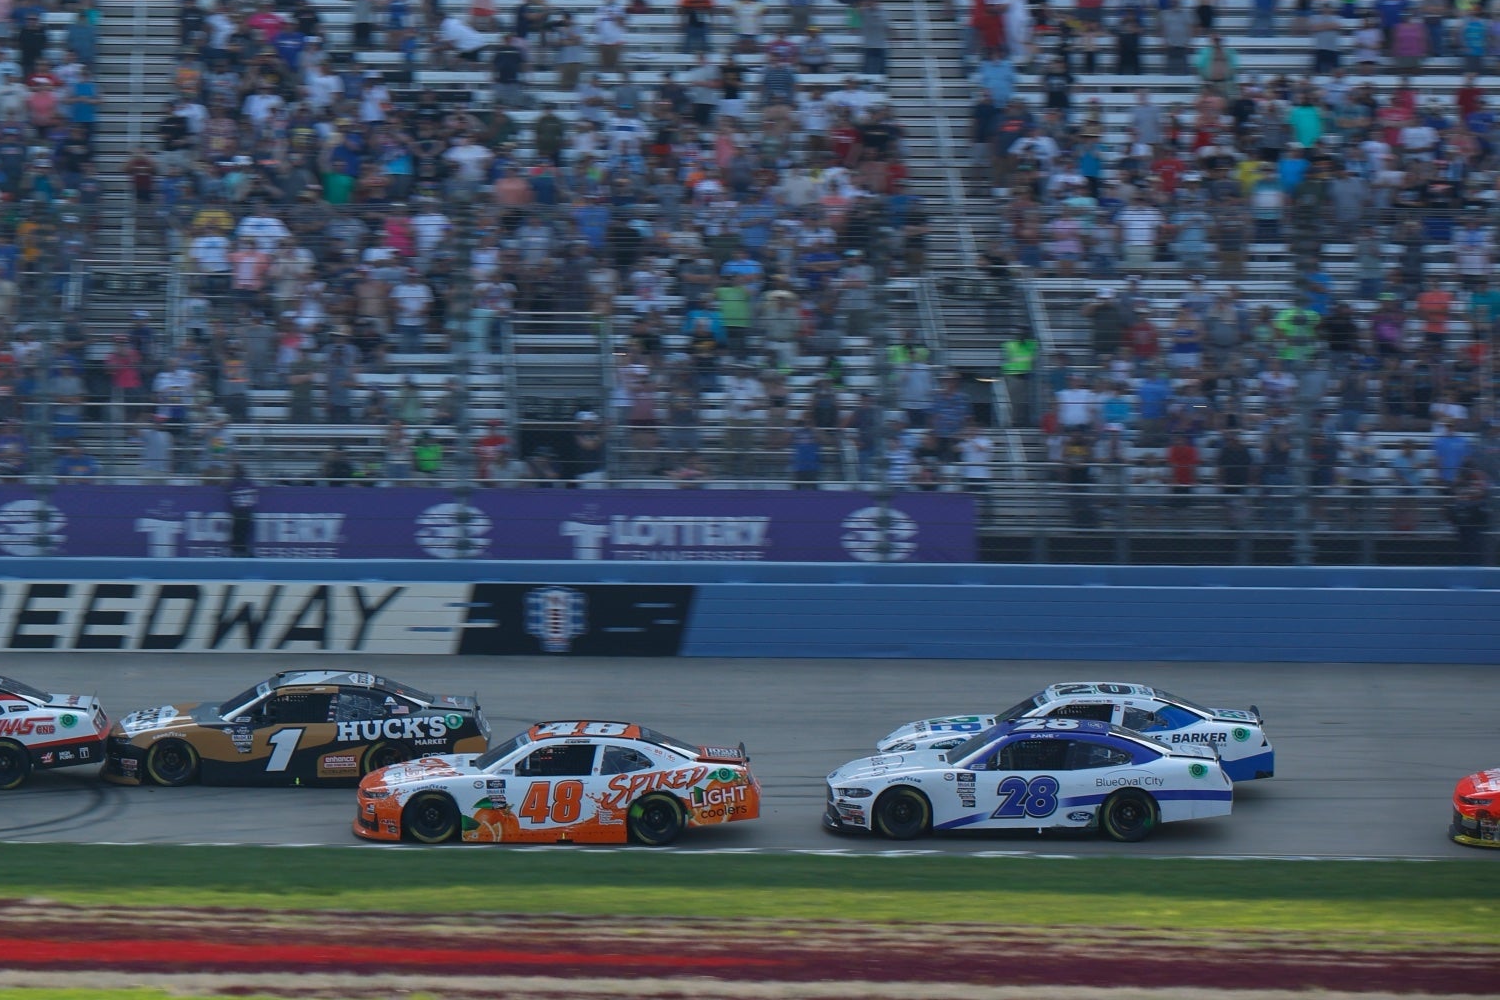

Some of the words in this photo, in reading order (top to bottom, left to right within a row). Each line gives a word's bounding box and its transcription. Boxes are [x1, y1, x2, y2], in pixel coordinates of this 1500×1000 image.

[609, 515, 772, 547] LOTTERY
[337, 717, 446, 741] HUCK'S
[1171, 732, 1228, 744] BARKER
[265, 727, 306, 771] 1
[414, 738, 448, 746] MARKET
[601, 766, 709, 810] SPIKED
[1145, 777, 1165, 788] City
[519, 780, 584, 824] 48
[690, 785, 748, 807] LIGHT
[989, 775, 1060, 820] 28
[701, 803, 747, 819] coolers
